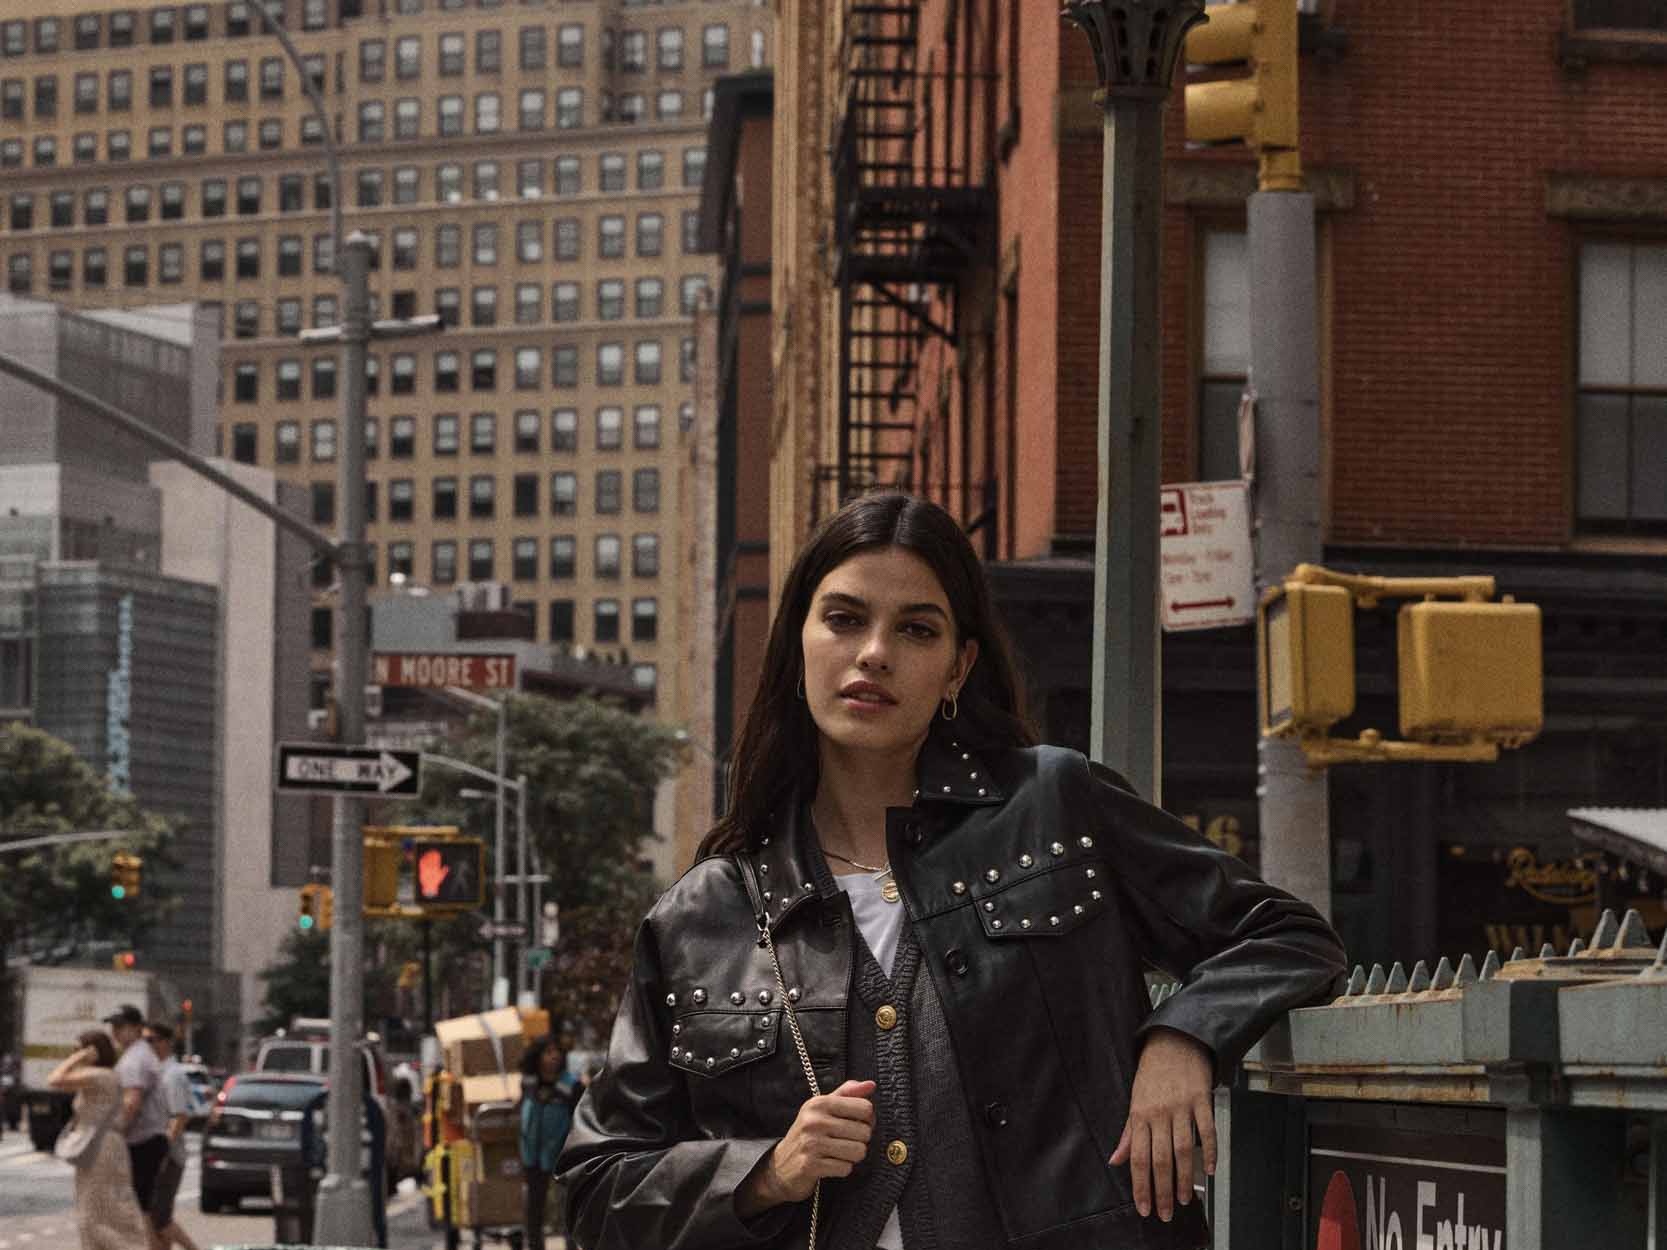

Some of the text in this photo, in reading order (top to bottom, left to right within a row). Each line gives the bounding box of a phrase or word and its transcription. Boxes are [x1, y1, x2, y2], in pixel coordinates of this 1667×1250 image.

[401, 656, 473, 684] MOORE
[484, 656, 509, 685] ST
[298, 760, 396, 778] ONE WAY
